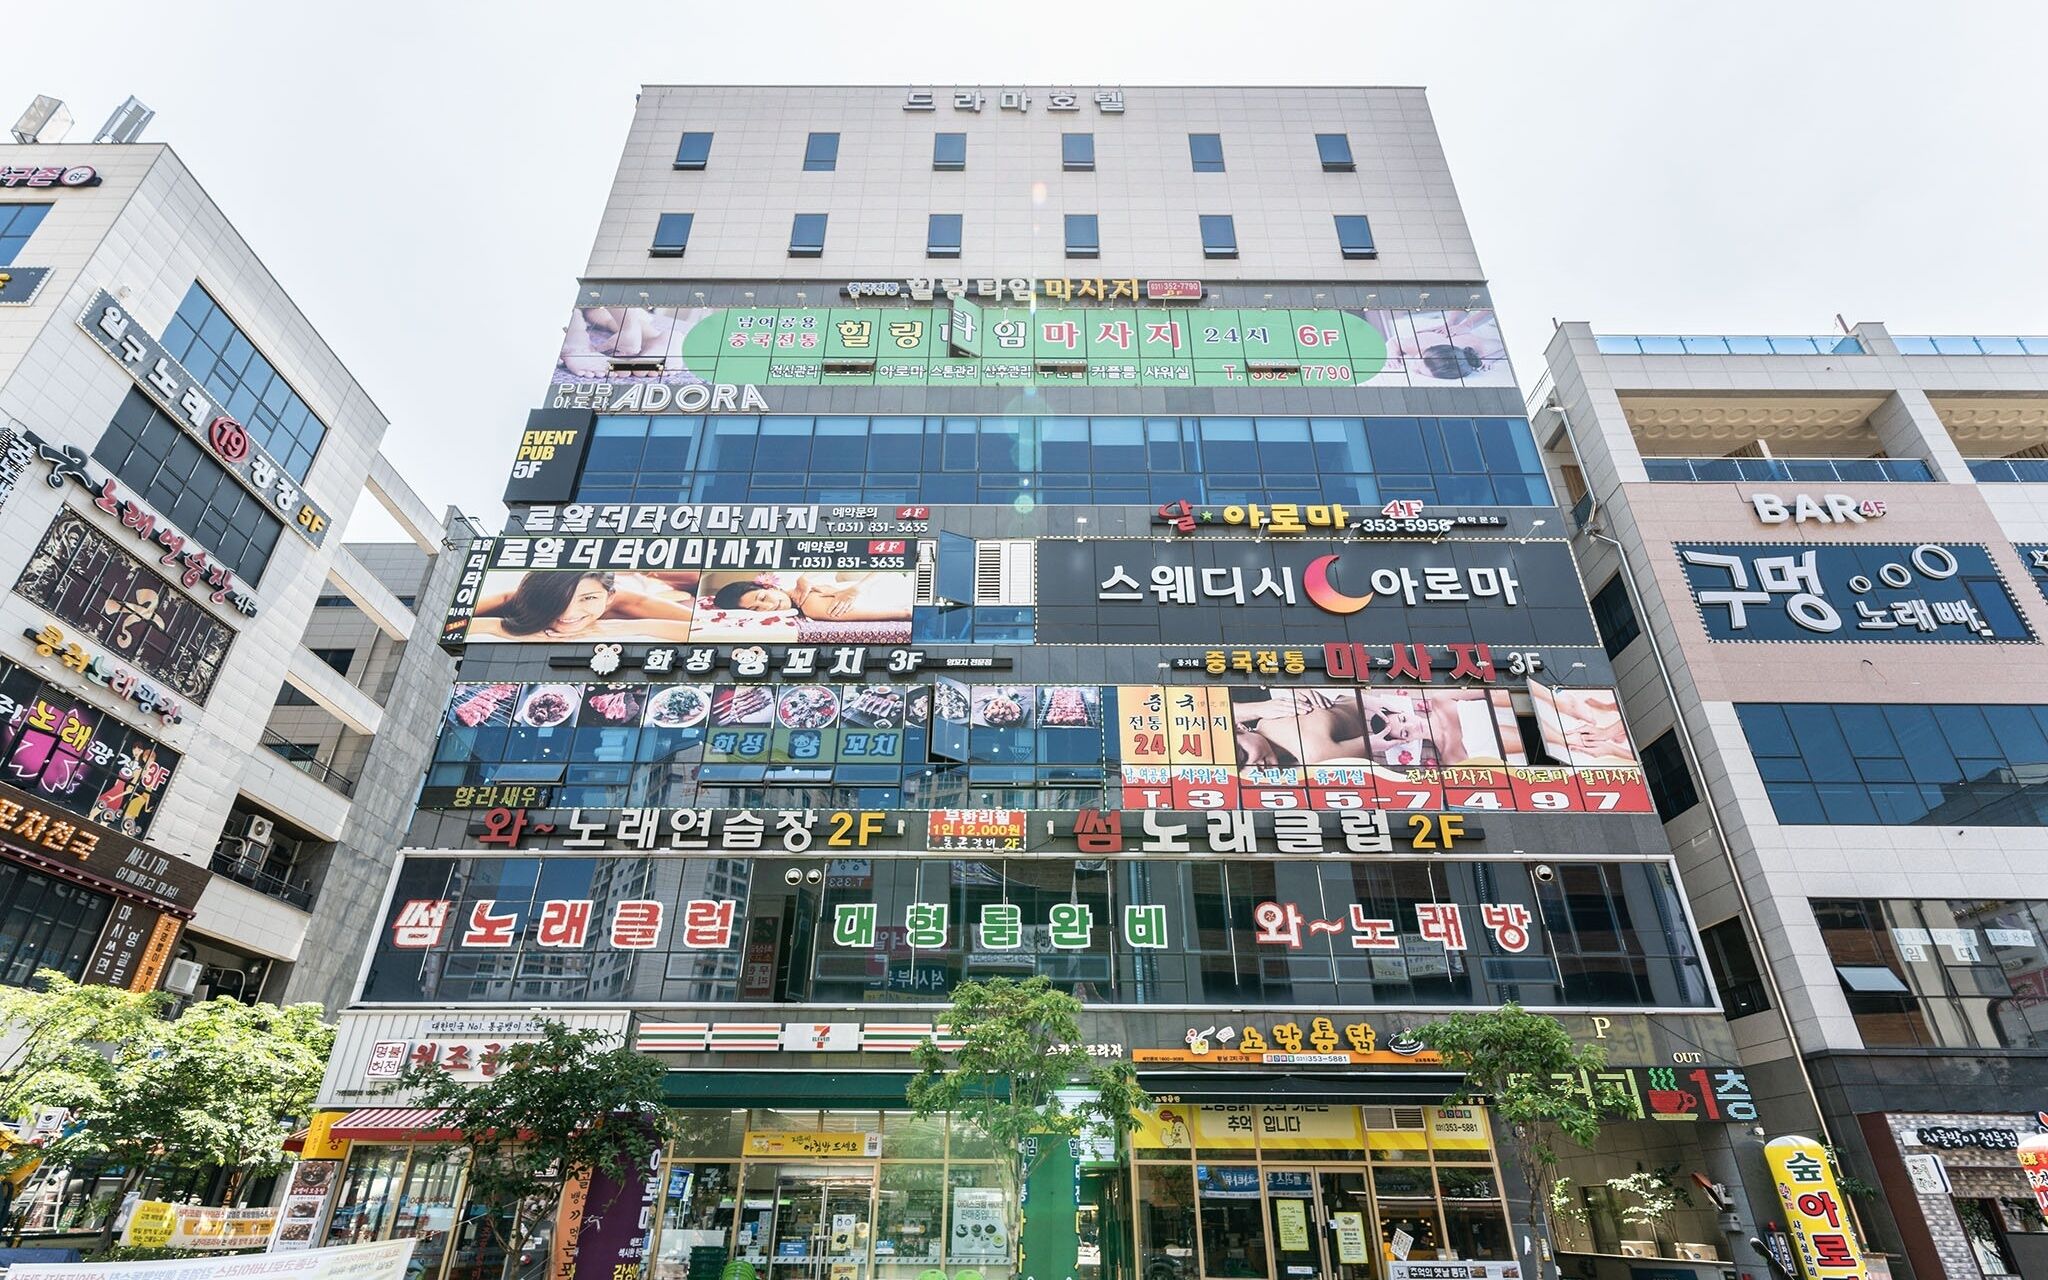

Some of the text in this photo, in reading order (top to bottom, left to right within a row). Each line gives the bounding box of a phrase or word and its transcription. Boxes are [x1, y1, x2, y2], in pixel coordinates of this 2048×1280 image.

[903, 91, 1126, 114] 드라마호텔
[69, 172, 87, 181] 6F
[848, 281, 899, 298] 중국전통
[906, 277, 1034, 301] 힐링타임
[1044, 278, 1139, 301] 마사지
[737, 315, 818, 330] 남여공용
[728, 332, 820, 349] 중국전통
[1043, 321, 1182, 350] 마사지
[1204, 326, 1270, 345] 24시
[1297, 325, 1339, 348] 6F
[770, 363, 819, 379] 전신관리
[879, 364, 926, 379] 아로마
[984, 365, 1032, 379] 산후관리
[1091, 365, 1137, 380] 커플룸
[1144, 365, 1192, 381] 샤워실
[1223, 365, 1243, 381] T.
[552, 396, 611, 410] 아도라
[557, 383, 770, 413] PUB ADORA
[100, 305, 326, 533] 일구 노래 19 광장 5F
[522, 430, 578, 446] EVENT
[517, 446, 556, 461] PUB
[512, 461, 542, 479] 5F
[832, 507, 878, 518] 예약문의
[901, 508, 925, 518] 4F
[1222, 503, 1350, 534] 아로마
[1381, 499, 1425, 520] 4F
[1751, 493, 1888, 525] BAR 4F
[826, 521, 864, 532] T.031)
[1363, 518, 1451, 533] 353-5958
[94, 477, 257, 613] 노래연습장 4F
[796, 541, 848, 554] 예약문의
[874, 542, 901, 552] 4F
[788, 556, 905, 569] T.031) 831-3635
[1099, 564, 1520, 606] 스웨디시 아로마
[1683, 549, 1843, 633] 구멍
[643, 648, 713, 671] 화성
[887, 649, 926, 672] 3F
[1204, 641, 1541, 684] 중국전통 마사지 3F
[1142, 693, 1196, 714] 중국
[1128, 714, 1229, 732] 전통 마사지
[28, 700, 171, 792] 노래 광장 3F
[713, 733, 765, 756] 화성
[1133, 733, 1204, 758] 24시
[1178, 767, 1642, 786] 샤워실 수면실 휴게실 전신 마사지 아로마 발마사지
[1141, 790, 1169, 810] T.
[562, 809, 819, 853] 노래연습장
[828, 812, 887, 848] 2F
[933, 824, 1021, 836] 1인 12,000원
[1073, 808, 1465, 854] 썸 노래클럽 2F
[1004, 838, 1020, 849] 2F
[392, 898, 447, 950] 썸
[461, 898, 737, 950] 노래클럽
[1348, 902, 1533, 954] 노래방
[431, 1021, 465, 1032] 대한민국
[1240, 1017, 1377, 1055] 노랑통닭
[1591, 1017, 1611, 1039] P
[813, 1025, 831, 1049] 7
[375, 1045, 402, 1059] 명불
[1673, 1052, 1702, 1063] OUT
[371, 1060, 398, 1074] 허전
[1688, 1068, 1759, 1120] 1층
[1227, 1115, 1302, 1133] 추억 입니다
[832, 1141, 858, 1152] 드세요
[1922, 1129, 2018, 1149] 차돌박이 전문점
[1784, 1151, 1824, 1182] 숲
